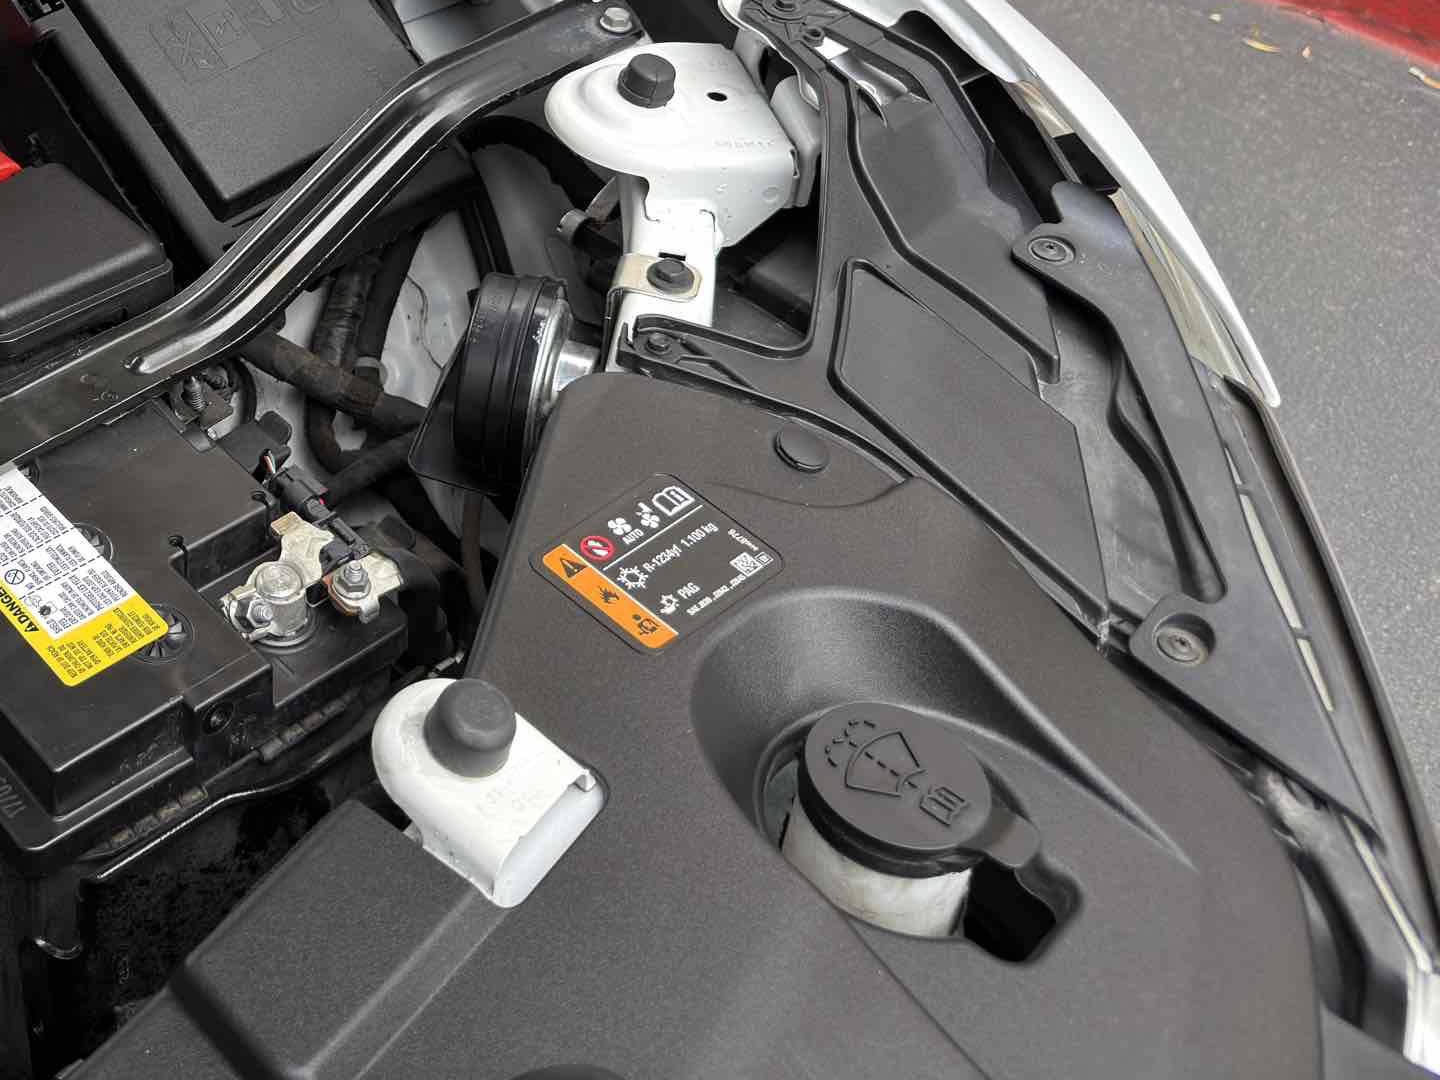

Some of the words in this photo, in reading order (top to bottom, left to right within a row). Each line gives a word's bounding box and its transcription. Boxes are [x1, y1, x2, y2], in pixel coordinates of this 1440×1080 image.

[620, 527, 645, 545] AUTO
[641, 543, 685, 574] R-1234yf
[678, 527, 707, 548] 1.100
[699, 520, 720, 535] kg
[675, 581, 701, 600] PAG
